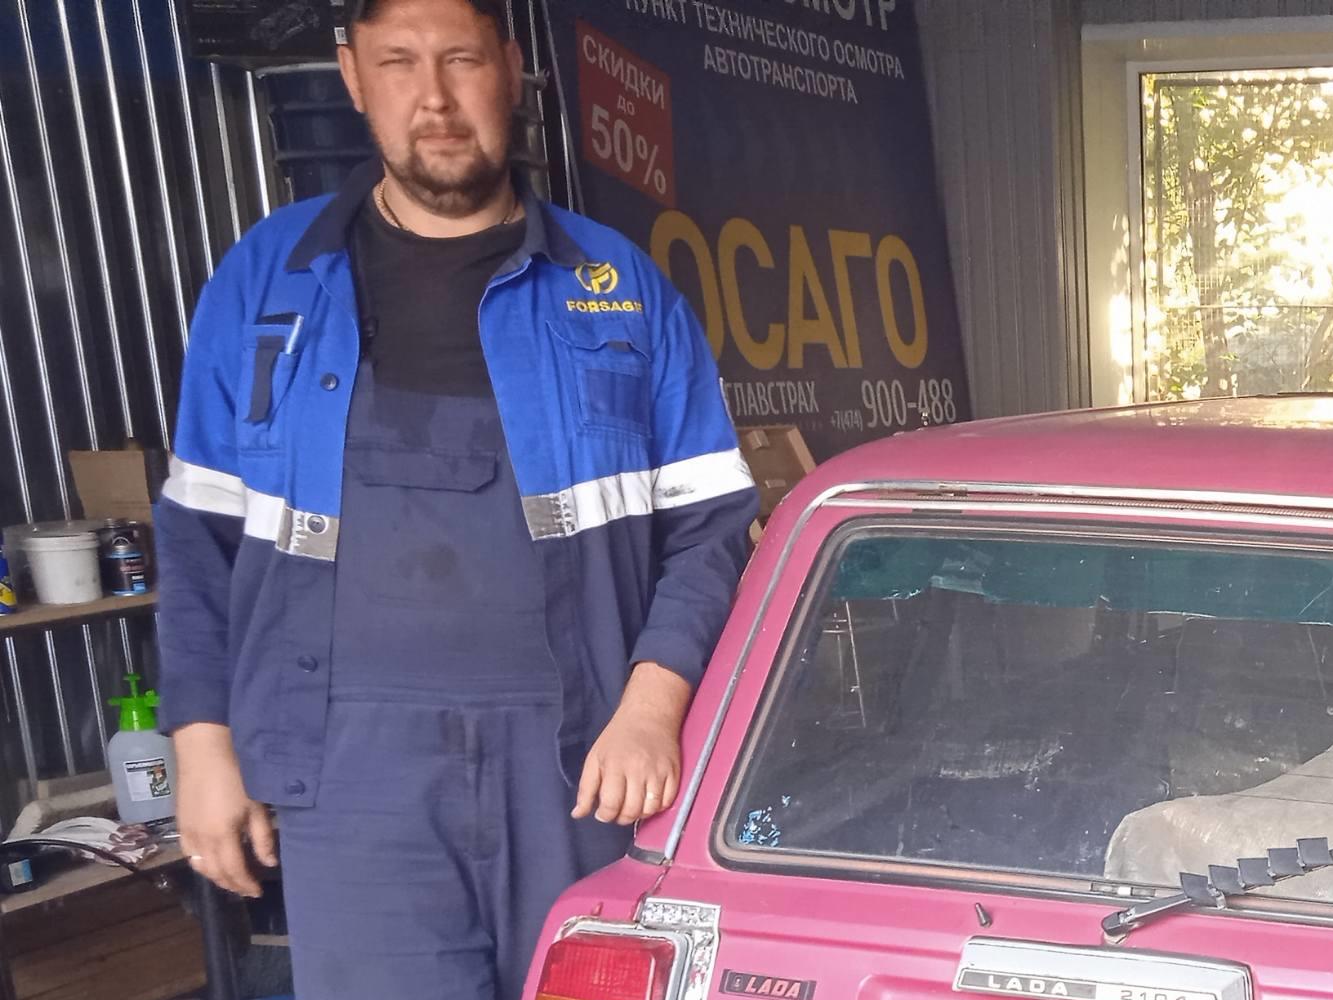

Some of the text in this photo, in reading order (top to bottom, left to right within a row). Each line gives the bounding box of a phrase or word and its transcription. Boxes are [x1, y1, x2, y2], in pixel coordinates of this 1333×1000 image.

[583, 34, 665, 109] СКИДКИ
[693, 2, 829, 60] ТЕХНИЧЕСКОГО
[834, 39, 905, 79] ОСМОТРА
[703, 44, 858, 104] АВТОТРАНСПОРТА
[591, 104, 667, 195] 50%
[650, 209, 929, 369] ОСАГО
[861, 378, 957, 428] 900-488
[745, 977, 802, 998] LADA
[988, 975, 1070, 997] LADA
